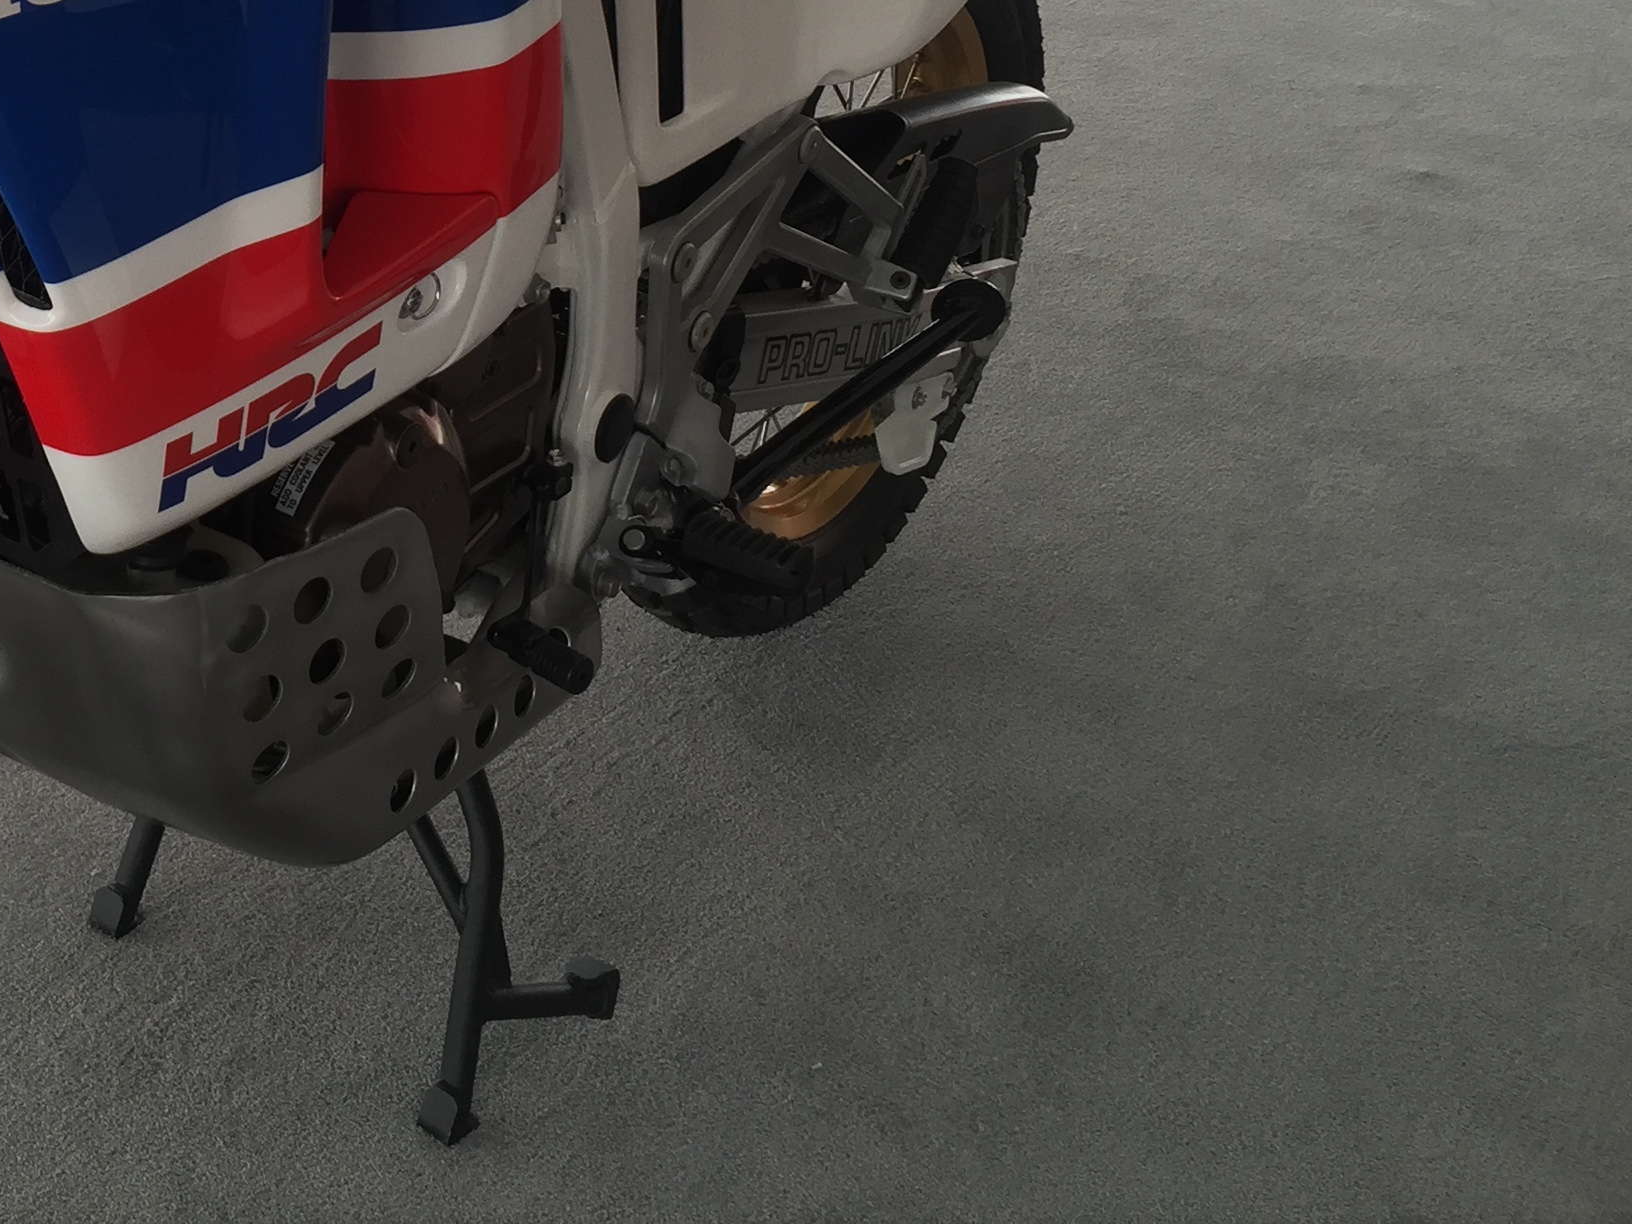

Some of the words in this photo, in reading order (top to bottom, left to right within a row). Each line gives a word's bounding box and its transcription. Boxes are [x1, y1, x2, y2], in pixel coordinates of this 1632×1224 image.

[157, 320, 383, 514] HRC
[311, 445, 330, 465] LEVEL
[289, 453, 313, 485] COOLANT
[290, 469, 313, 493] UPPER
[286, 498, 297, 509] TO
